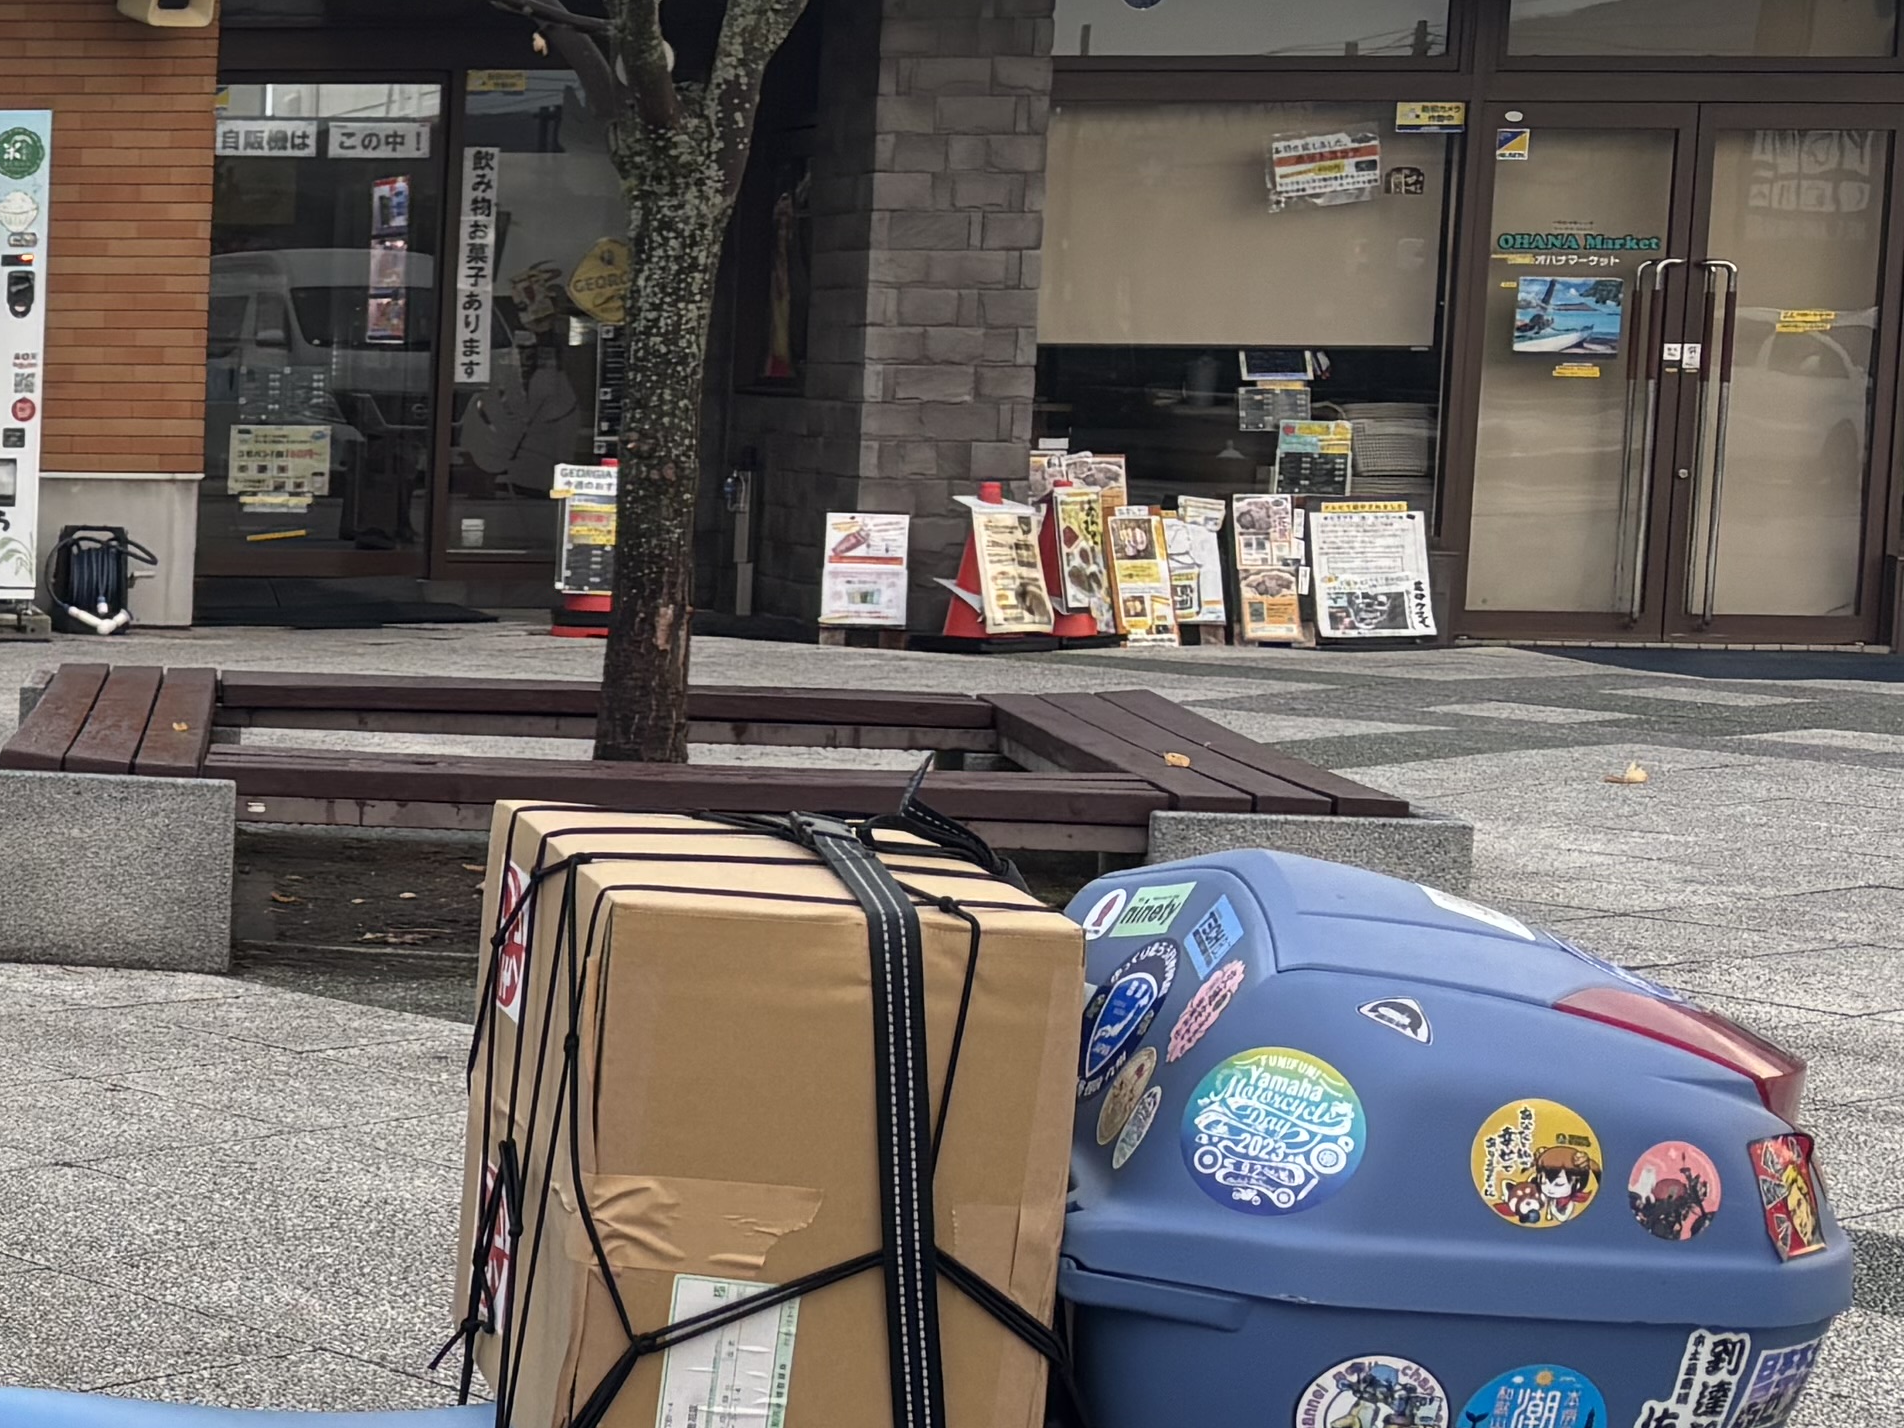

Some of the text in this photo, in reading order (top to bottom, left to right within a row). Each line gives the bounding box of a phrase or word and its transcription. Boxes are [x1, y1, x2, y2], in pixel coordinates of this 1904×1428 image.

[222, 130, 310, 151] 自販機は
[1498, 232, 1661, 251] OHANA Market
[462, 150, 495, 379] 飲み物お菓子あります
[1534, 255, 1620, 267] オハナマーケット
[1250, 1066, 1324, 1101] Yamaha
[1237, 1133, 1286, 1162] 2023
